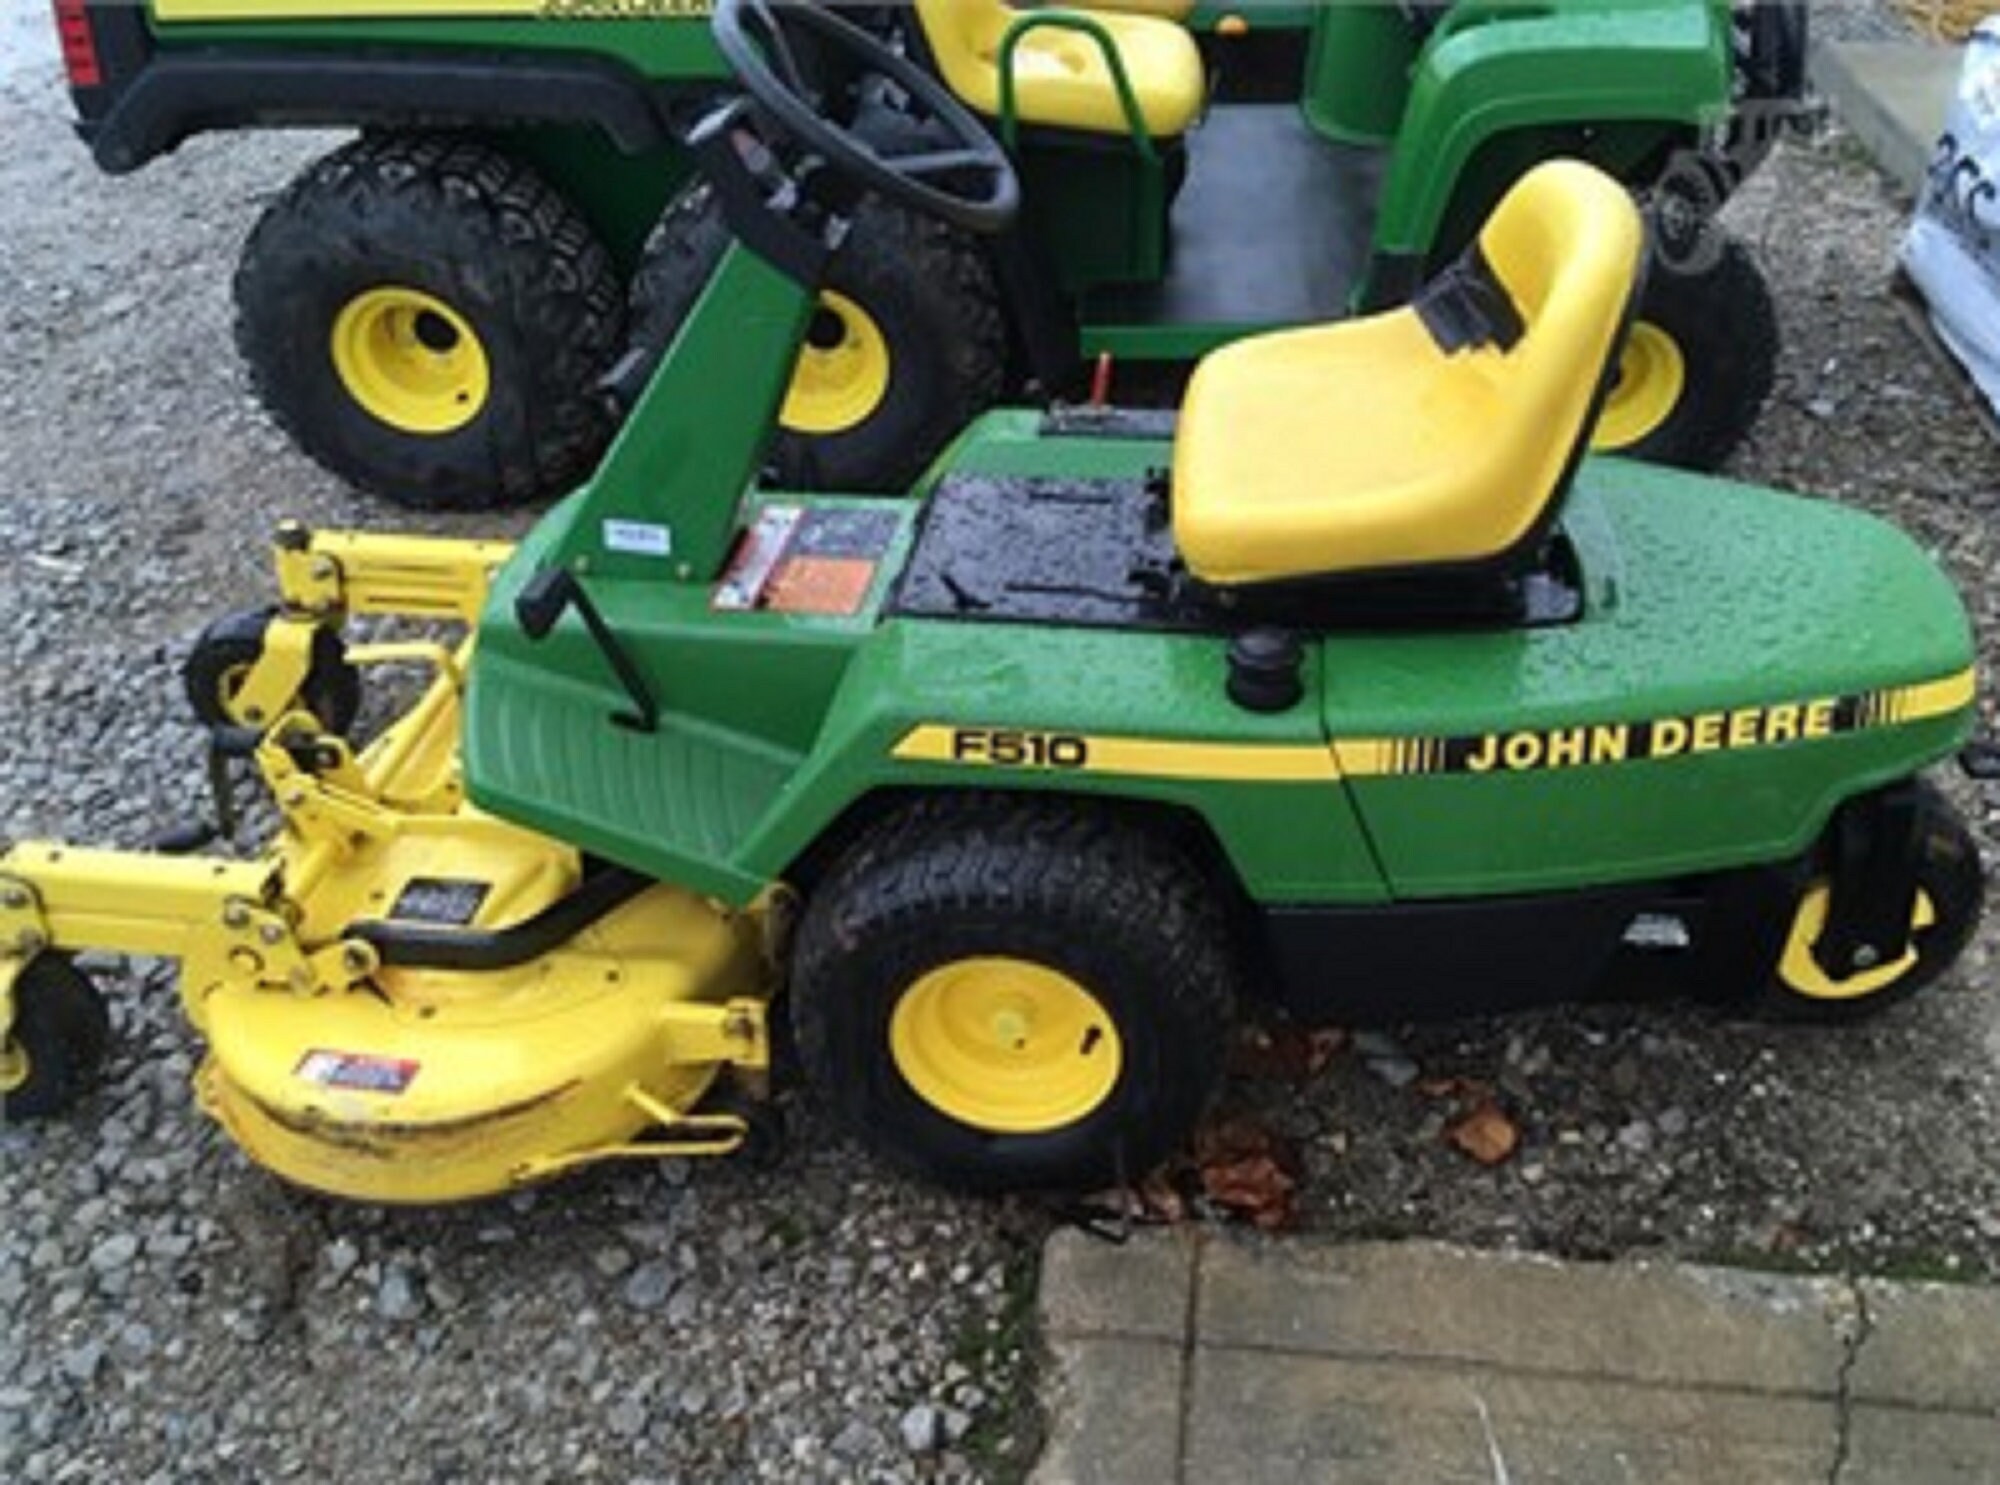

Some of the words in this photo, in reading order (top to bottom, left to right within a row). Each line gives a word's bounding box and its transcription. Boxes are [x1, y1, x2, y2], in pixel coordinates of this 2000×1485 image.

[954, 731, 1086, 766] F510
[1467, 727, 1627, 771] JOHN
[1649, 698, 1837, 757] DEERE
